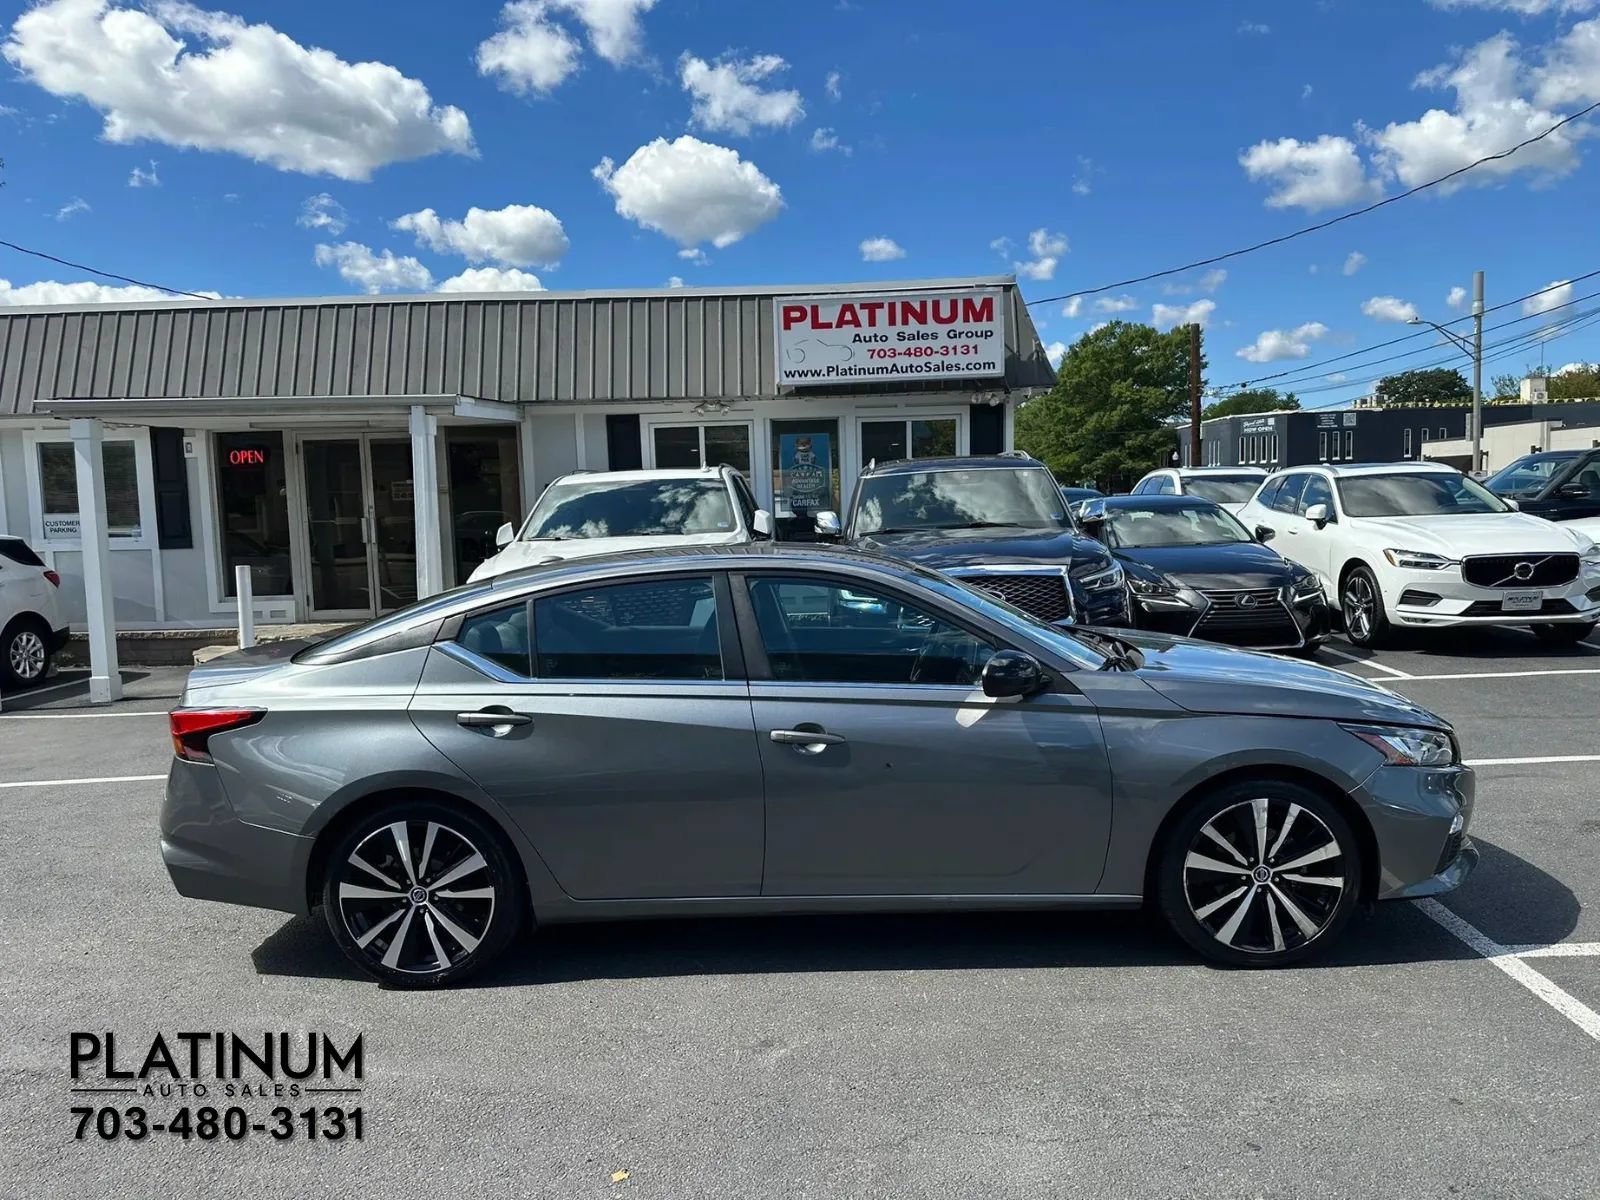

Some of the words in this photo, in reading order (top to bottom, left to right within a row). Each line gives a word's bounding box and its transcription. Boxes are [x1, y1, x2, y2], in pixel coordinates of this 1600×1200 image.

[782, 297, 994, 330] PLATINUM
[852, 333, 888, 344] Auto
[896, 330, 939, 341] Sales
[946, 328, 994, 340] Group
[867, 344, 979, 359] 703-480-3131
[784, 361, 995, 378] www.PlatinumAutoSales.com
[230, 449, 264, 464] OPEN
